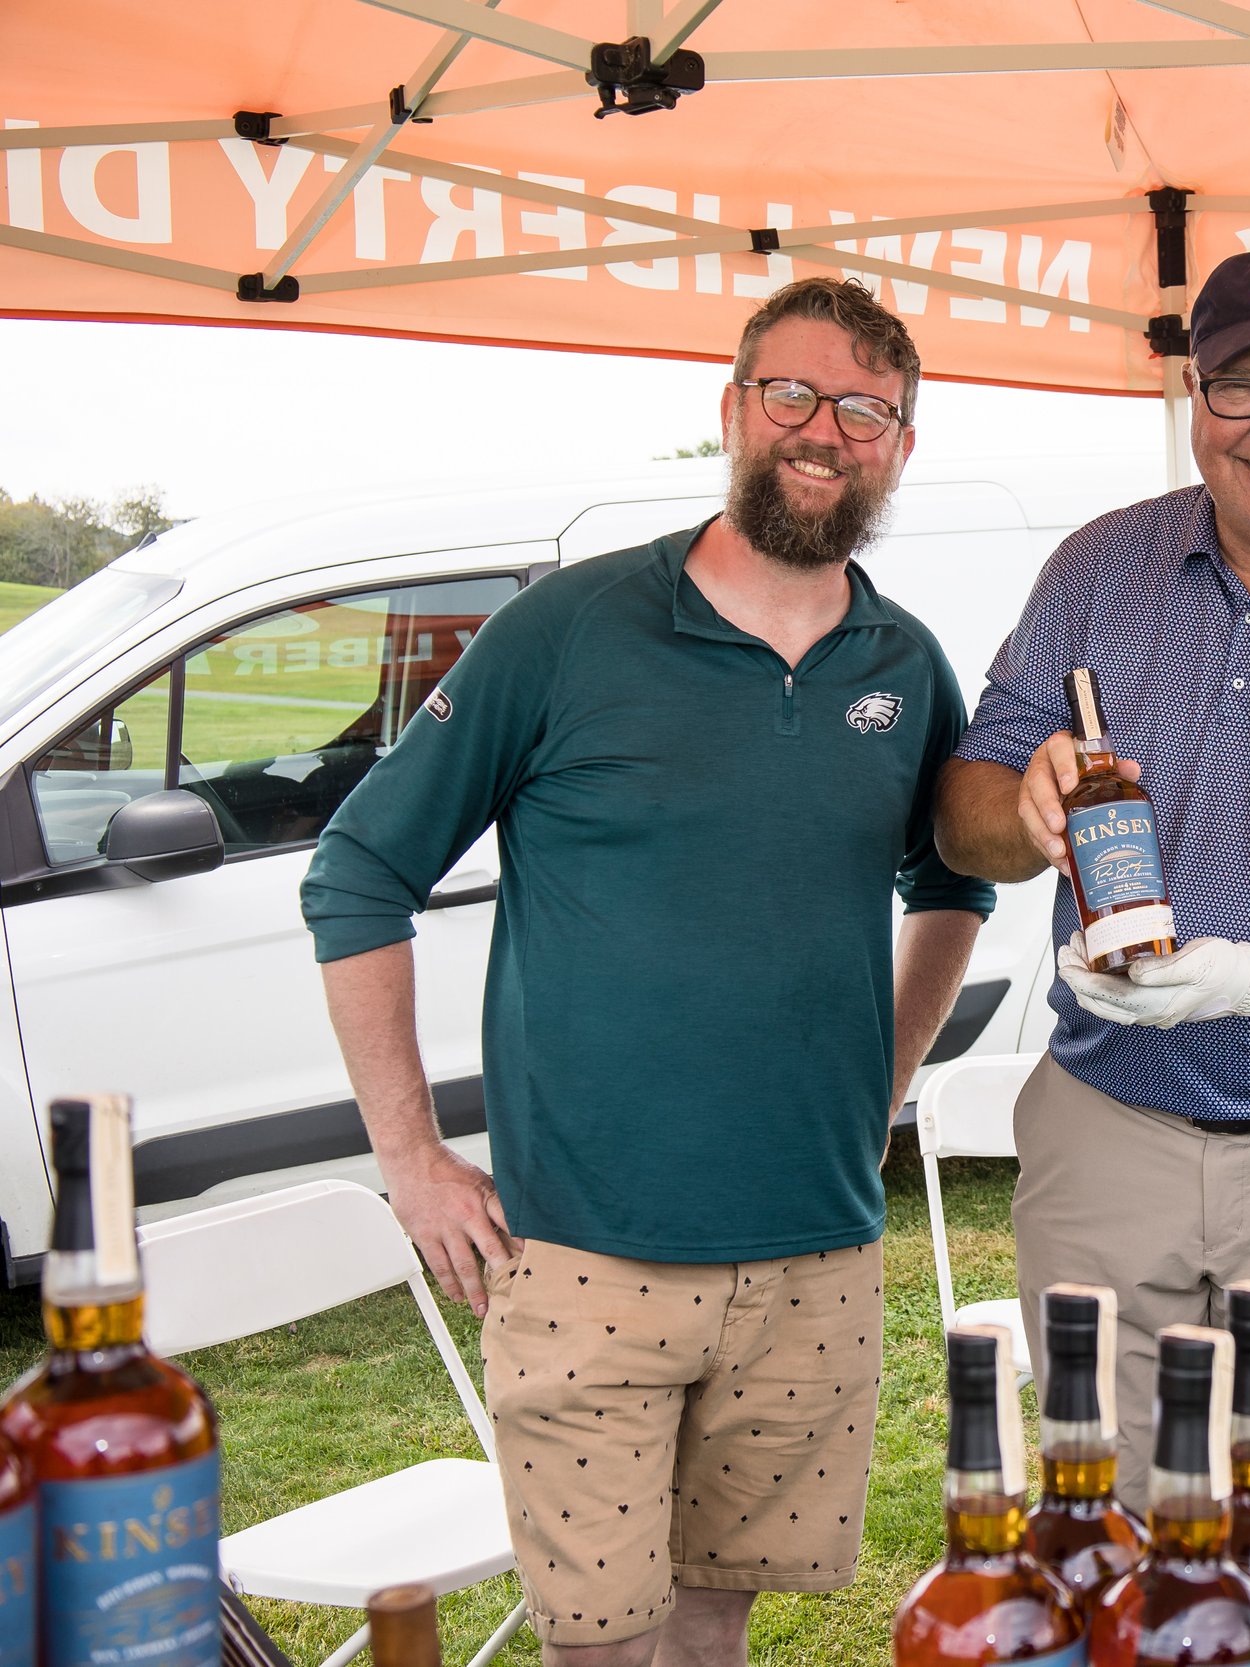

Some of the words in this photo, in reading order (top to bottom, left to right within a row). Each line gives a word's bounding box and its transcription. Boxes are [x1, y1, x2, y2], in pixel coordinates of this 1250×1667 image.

[1074, 818, 1152, 847] KINSEY
[1094, 845, 1118, 862] BOURBON
[1121, 843, 1146, 853] WHISKEY
[53, 1495, 217, 1564] KINSE
